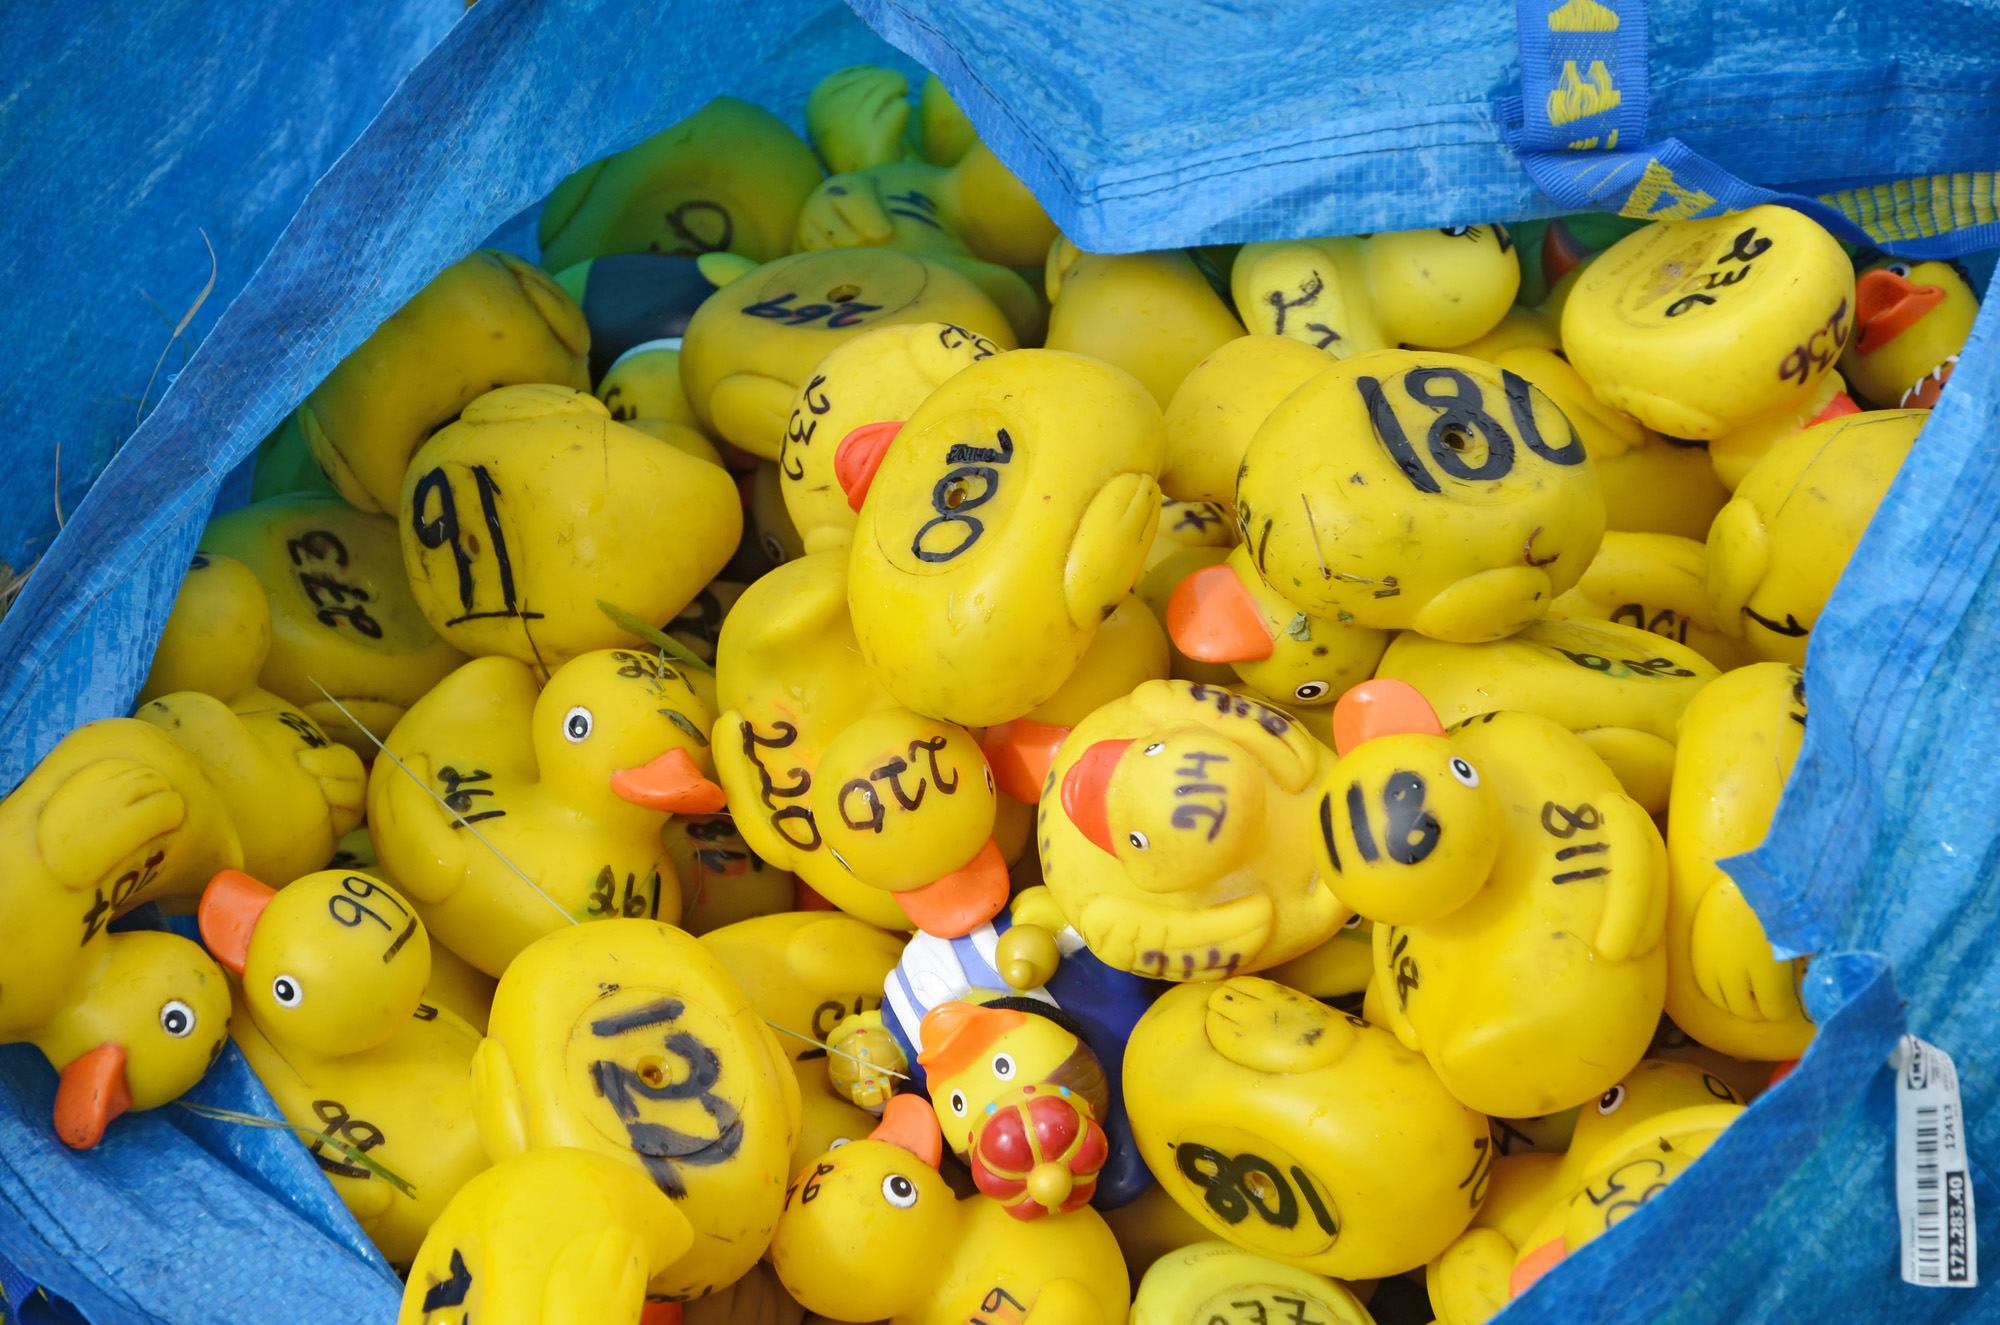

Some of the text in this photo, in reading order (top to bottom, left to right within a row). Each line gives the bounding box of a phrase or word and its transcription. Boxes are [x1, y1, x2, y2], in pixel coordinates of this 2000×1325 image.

[1665, 227, 1773, 318] 236
[1779, 298, 1850, 386] 236
[779, 373, 831, 482] 232
[1356, 366, 1587, 494] 180
[911, 427, 1013, 563] 100
[739, 720, 823, 852] 220
[838, 735, 958, 834] 220
[1171, 750, 1230, 842] 214
[1319, 769, 1441, 874] 118
[587, 864, 661, 919] 261
[1540, 800, 1611, 885] 118
[1175, 1142, 1338, 1237] 108
[1949, 1178, 1965, 1278] 172.283.40
